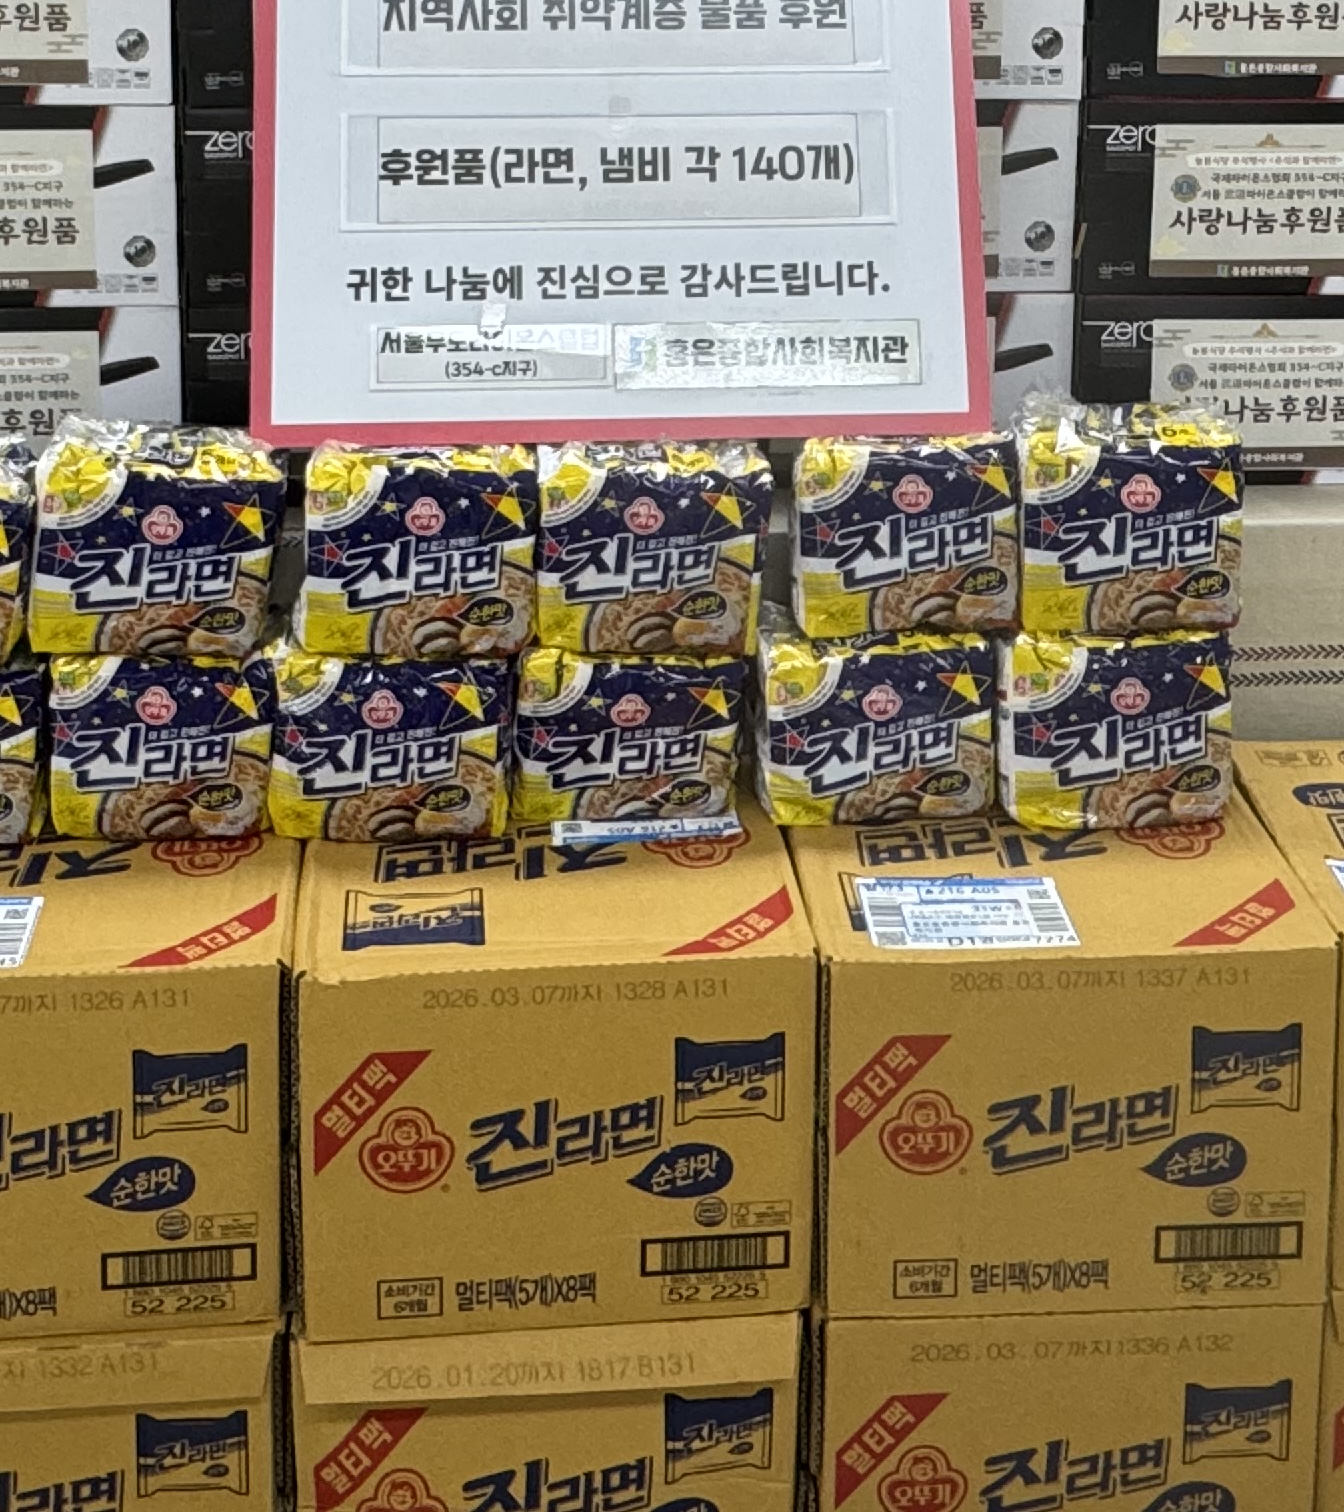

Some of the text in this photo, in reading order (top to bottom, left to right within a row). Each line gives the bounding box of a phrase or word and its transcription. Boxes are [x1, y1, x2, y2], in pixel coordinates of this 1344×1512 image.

[379, 143, 856, 191] 후원품(라면, 냄비 각 140개)
[347, 261, 890, 303] 귀한 나눔에 진심으로 감사드립니다.
[70, 544, 244, 613] 진라면
[341, 534, 504, 612] 진라면
[559, 534, 721, 605] 진라면
[836, 508, 994, 592] 진라면
[1058, 510, 1219, 587] 진라면
[69, 722, 236, 792] 진라면
[298, 726, 459, 797] 진라면
[546, 724, 708, 789] 진라면
[805, 716, 961, 799] 진라면
[1051, 712, 1209, 791] 진라면
[131, 989, 191, 1010] A131
[320, 1059, 398, 1139] 멀티팩
[841, 1043, 918, 1119] 멀티팩
[376, 1147, 438, 1175] 오뚜기
[465, 1094, 664, 1192] 진라면
[896, 1129, 957, 1158] 오뚜기
[983, 1084, 1180, 1176] 진라면
[1165, 1140, 1234, 1180] 순한맛
[109, 1163, 183, 1208] 순한맛
[649, 1149, 720, 1190] 순한맛
[667, 1281, 761, 1303] 52 225
[981, 1437, 1172, 1512] 진라면
